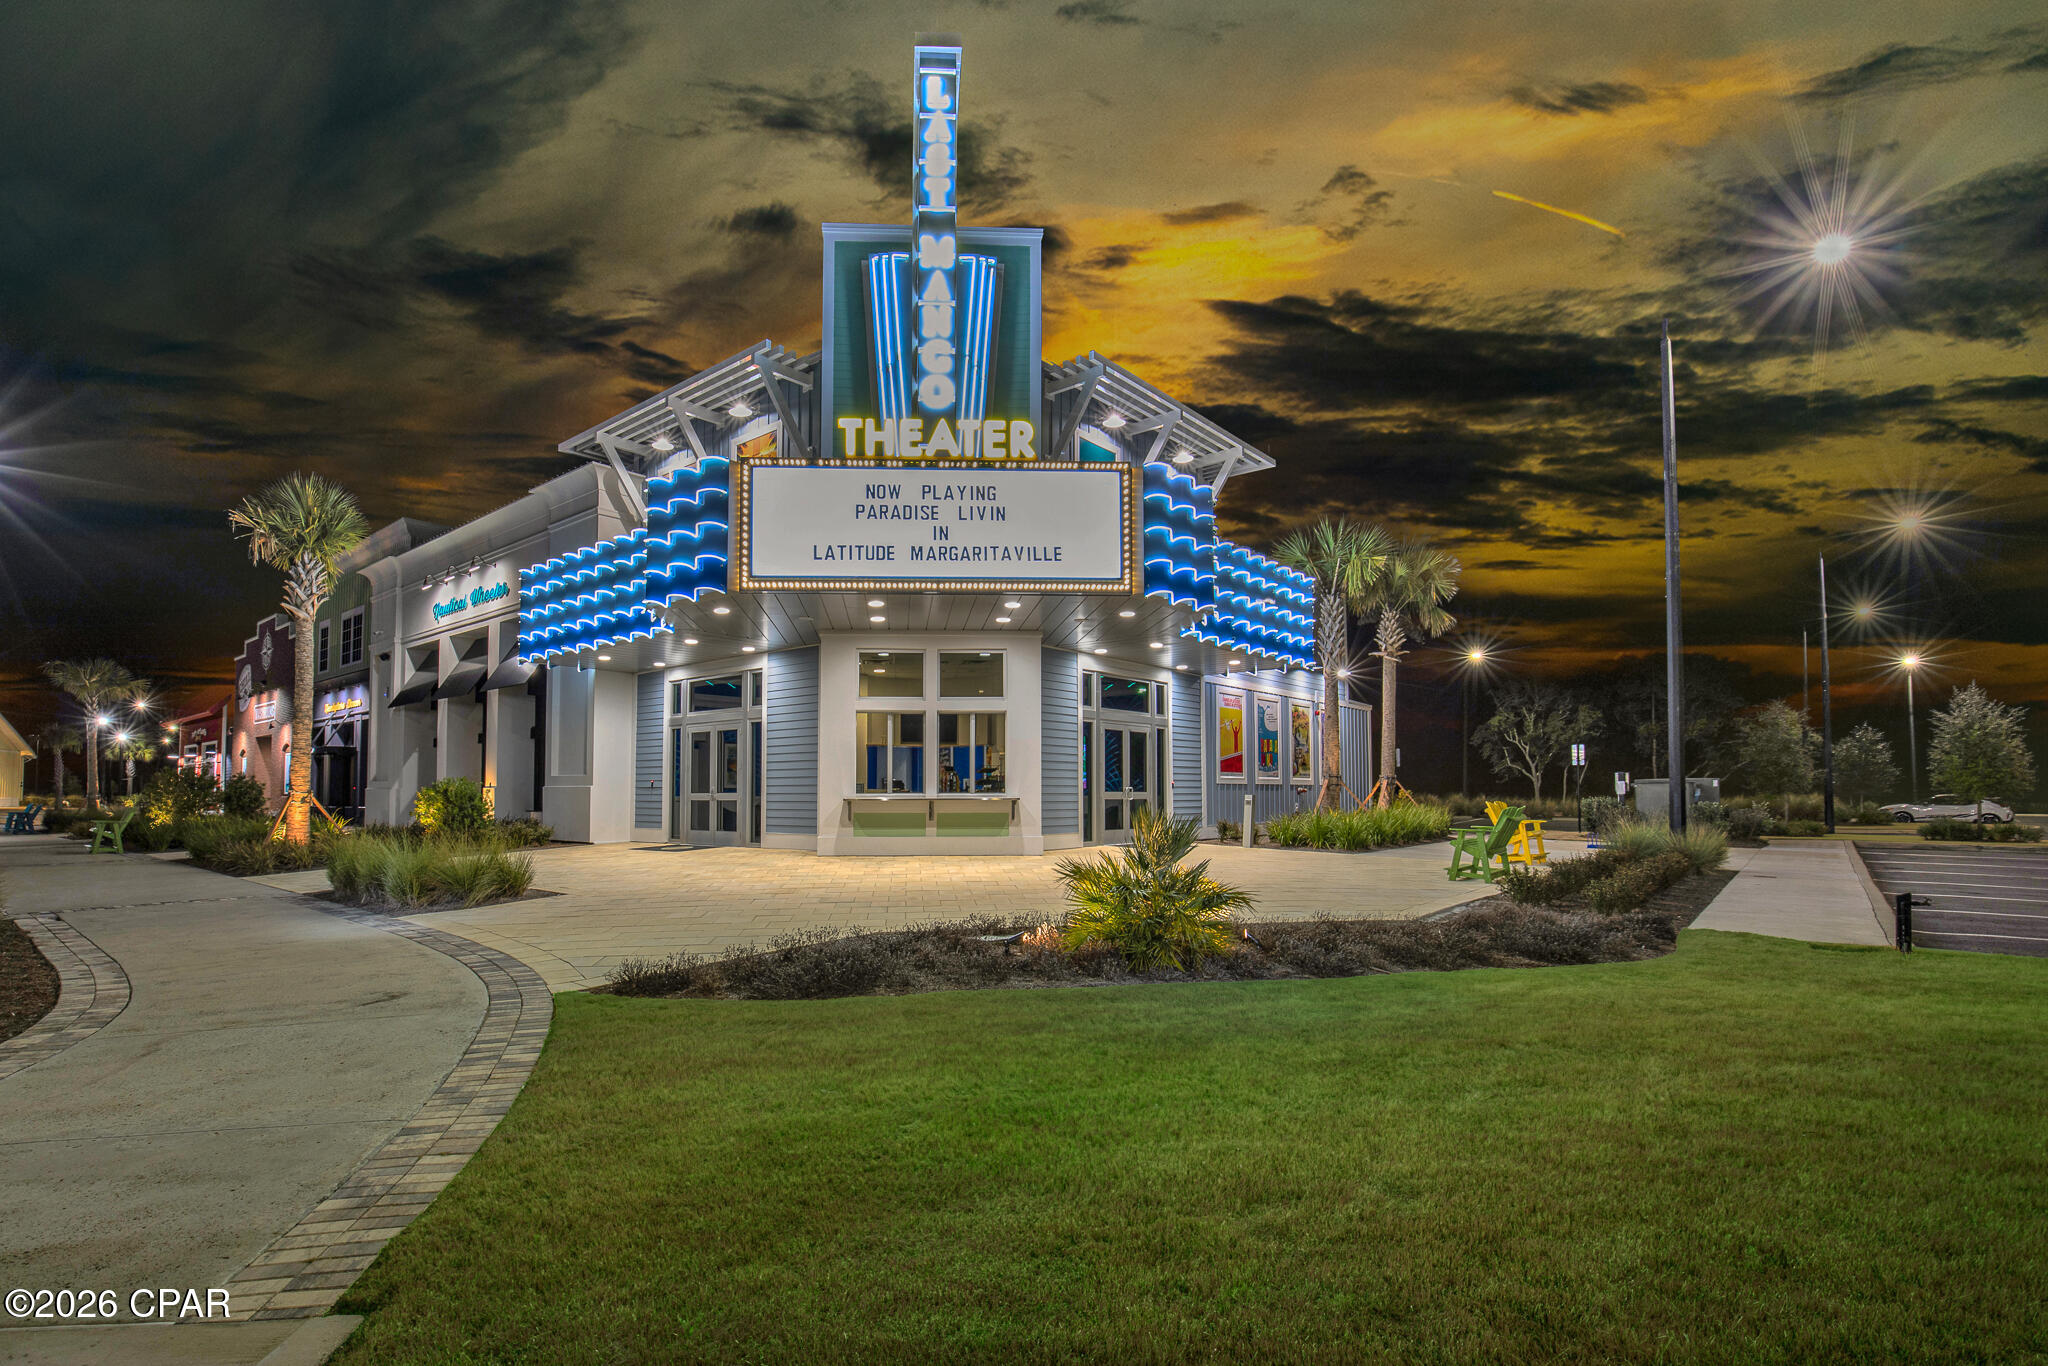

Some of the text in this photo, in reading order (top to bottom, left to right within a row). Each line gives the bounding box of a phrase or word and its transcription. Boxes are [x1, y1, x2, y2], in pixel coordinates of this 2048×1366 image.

[919, 75, 956, 410] LAST MANGO
[838, 418, 1037, 459] THEATER
[865, 483, 997, 501] NOW PLAYING
[855, 504, 1007, 522] PARADISE LIVIN
[933, 525, 950, 541] IN
[813, 544, 1063, 562] LATITUDE MARGARITAVILLE
[433, 594, 467, 622] Nautical
